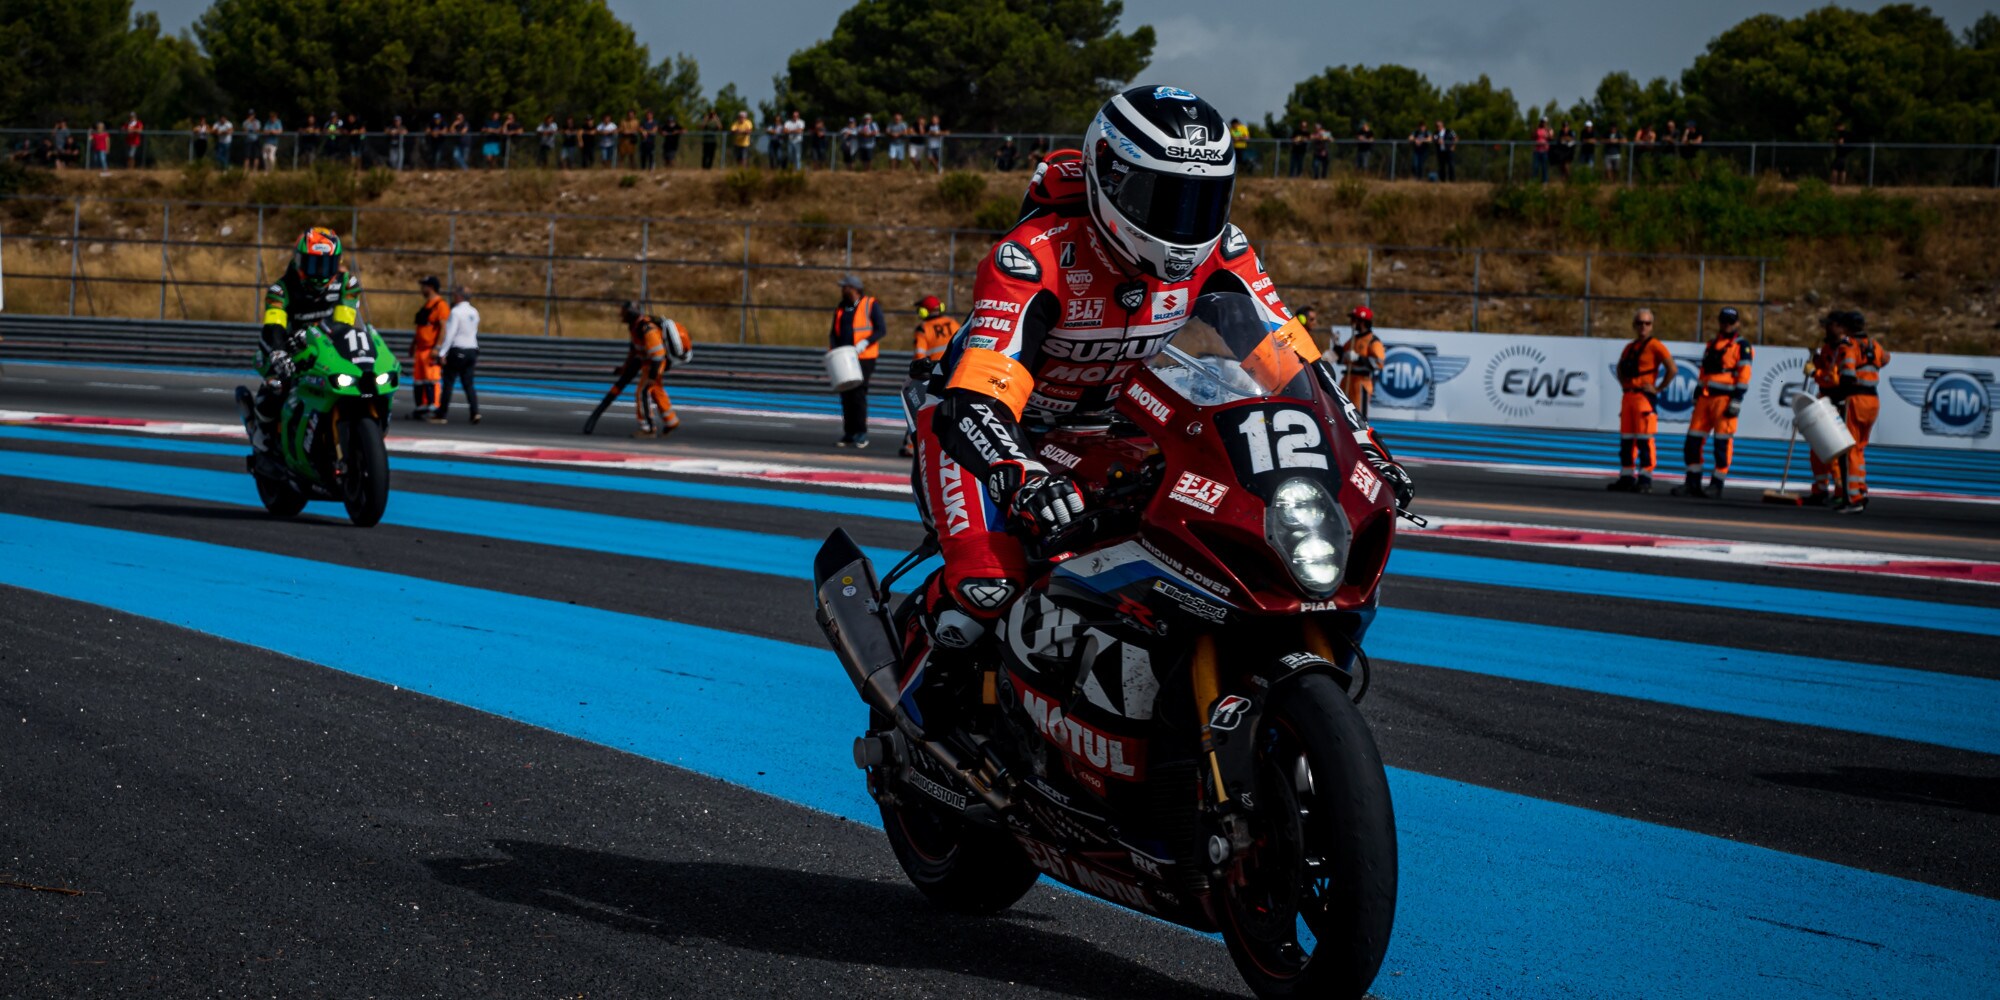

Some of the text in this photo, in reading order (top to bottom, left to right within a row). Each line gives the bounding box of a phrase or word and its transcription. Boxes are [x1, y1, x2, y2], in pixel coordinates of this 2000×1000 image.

[1167, 146, 1224, 160] SHARK
[1030, 222, 1069, 245] IXON
[1065, 272, 1093, 284] MOTO
[1153, 309, 1185, 320] SUZUKI
[344, 329, 371, 352] 11
[933, 322, 952, 339] RT
[1381, 361, 1424, 390] FIM
[1502, 367, 1588, 398] EWC
[1127, 383, 1170, 422] MOTUL
[1936, 388, 1979, 417] FIM
[970, 403, 1028, 459] IXON
[1238, 408, 1329, 475] 12
[1040, 443, 1082, 469] SUZUKI
[1141, 538, 1231, 597] IRIDIUM POWER
[1301, 601, 1337, 612] PIAA
[1023, 690, 1136, 777] MOTUL
[910, 768, 966, 809] BRIDGESTONE
[1130, 851, 1164, 880] RK
